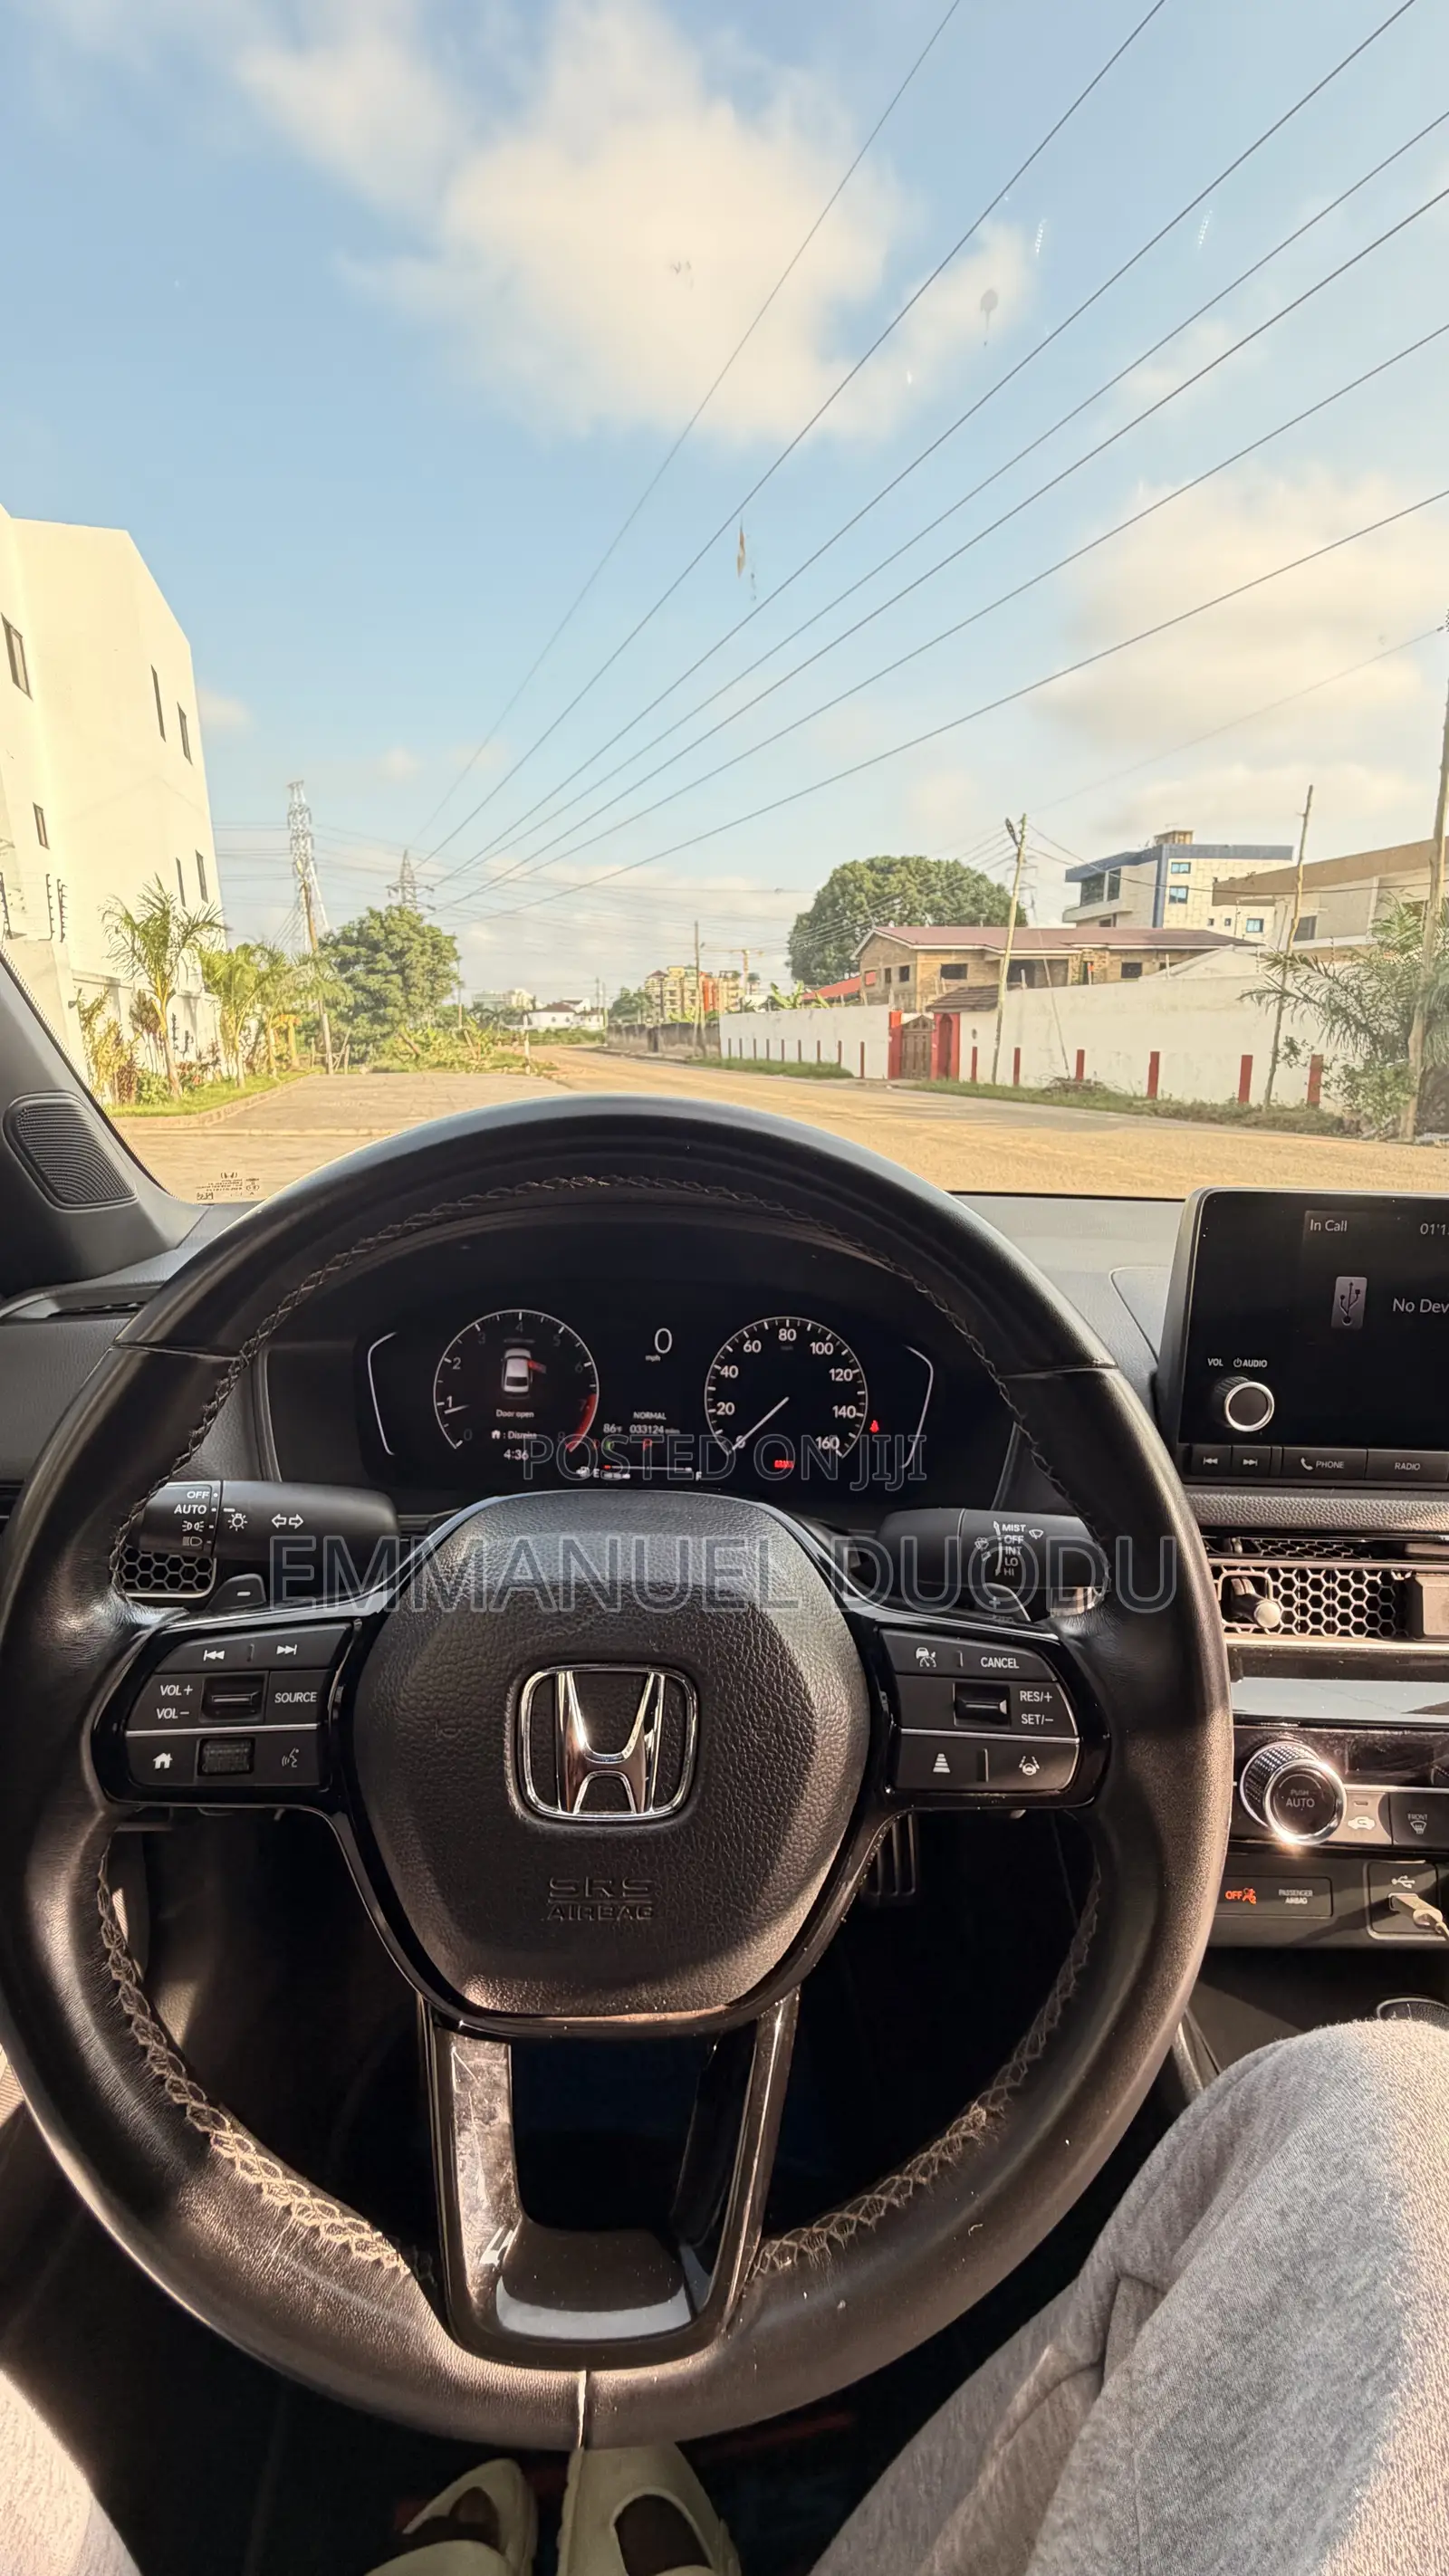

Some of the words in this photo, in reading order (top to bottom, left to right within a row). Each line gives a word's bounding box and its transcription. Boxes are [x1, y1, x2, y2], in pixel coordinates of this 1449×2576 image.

[1310, 1220, 1321, 1231] In
[1324, 1220, 1348, 1232] Call
[1420, 1222, 1449, 1236] 01'1
[1392, 1298, 1415, 1313] No
[778, 1327, 797, 1342] 80
[654, 1327, 673, 1355] 0
[743, 1339, 763, 1354] 60
[810, 1341, 834, 1356] 100
[452, 1356, 462, 1371] 2
[1207, 1357, 1223, 1367] VOL
[1243, 1359, 1268, 1368] AUDIO
[720, 1365, 739, 1379] 40
[829, 1367, 853, 1383] 120
[446, 1395, 453, 1408] 1
[495, 1409, 514, 1418] Door
[716, 1402, 735, 1416] 20
[832, 1404, 857, 1420] 140
[633, 1411, 667, 1421] NORMAL
[629, 1424, 664, 1434] 033124
[816, 1436, 840, 1450] 160
[504, 1449, 530, 1460] 4:36
[1315, 1459, 1345, 1470] PHONE
[1394, 1461, 1421, 1471] RADIO
[187, 1490, 209, 1500] OFF
[174, 1504, 207, 1515] AUTO
[1002, 1523, 1027, 1533] MIST
[1003, 1534, 1024, 1545] OFF
[1005, 1545, 1022, 1556] INT
[1004, 1556, 1019, 1567] LO
[1003, 1567, 1015, 1577] HI
[980, 1657, 1020, 1669] CANCEL
[273, 1691, 317, 1704] SOURCE
[1291, 1789, 1310, 1797] PUSH
[1285, 1798, 1316, 1809] AUTO
[548, 1876, 653, 1899] SRS
[1224, 1891, 1243, 1901] OFF
[547, 1903, 653, 1921] AIRBAG
